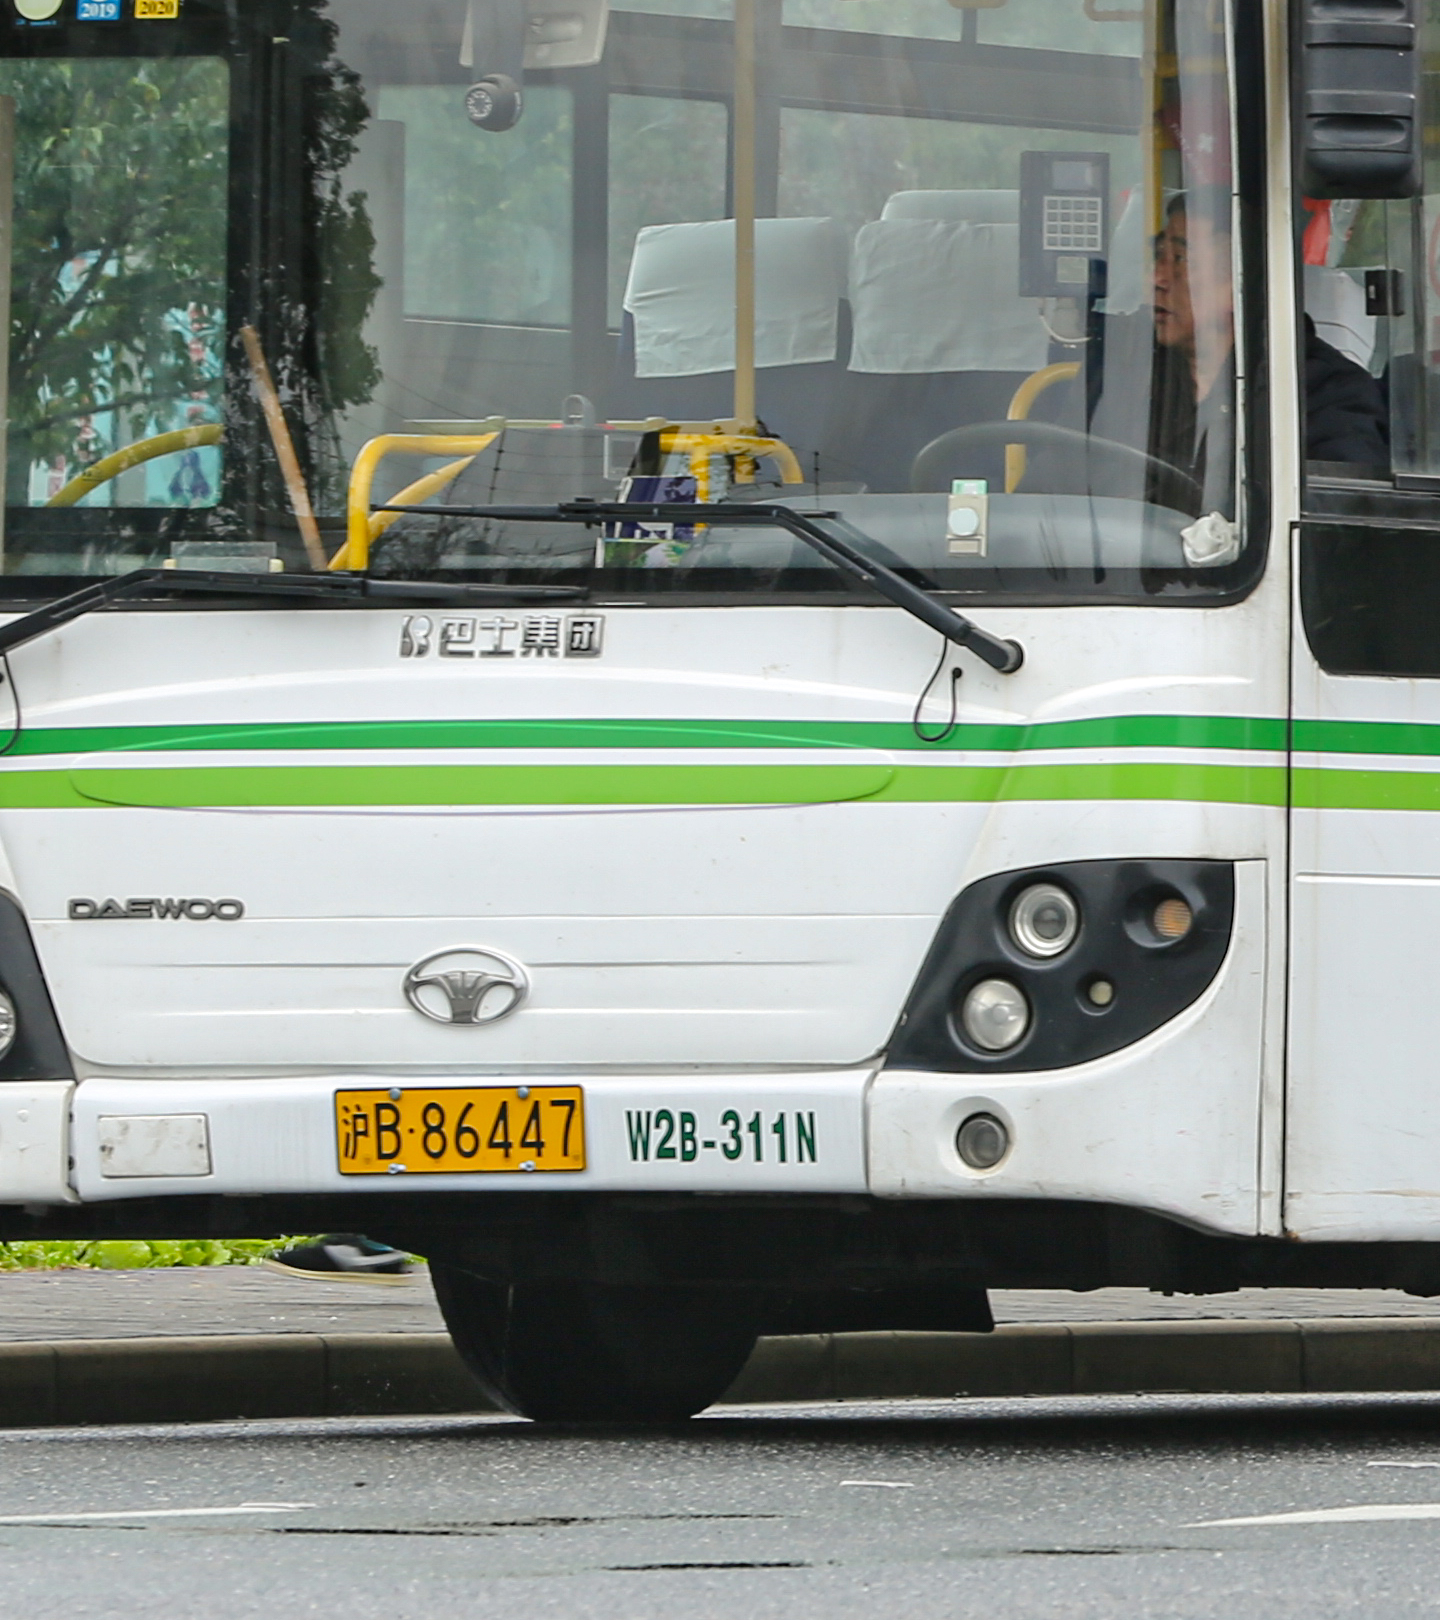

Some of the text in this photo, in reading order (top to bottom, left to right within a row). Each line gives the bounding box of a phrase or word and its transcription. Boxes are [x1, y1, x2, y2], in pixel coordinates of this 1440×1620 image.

[80, 3, 116, 18] 2019
[140, 1, 174, 15] 2020
[438, 613, 606, 659] 巴士集团
[69, 897, 245, 921] DAEWOO
[624, 1108, 818, 1164] W2B-311N
